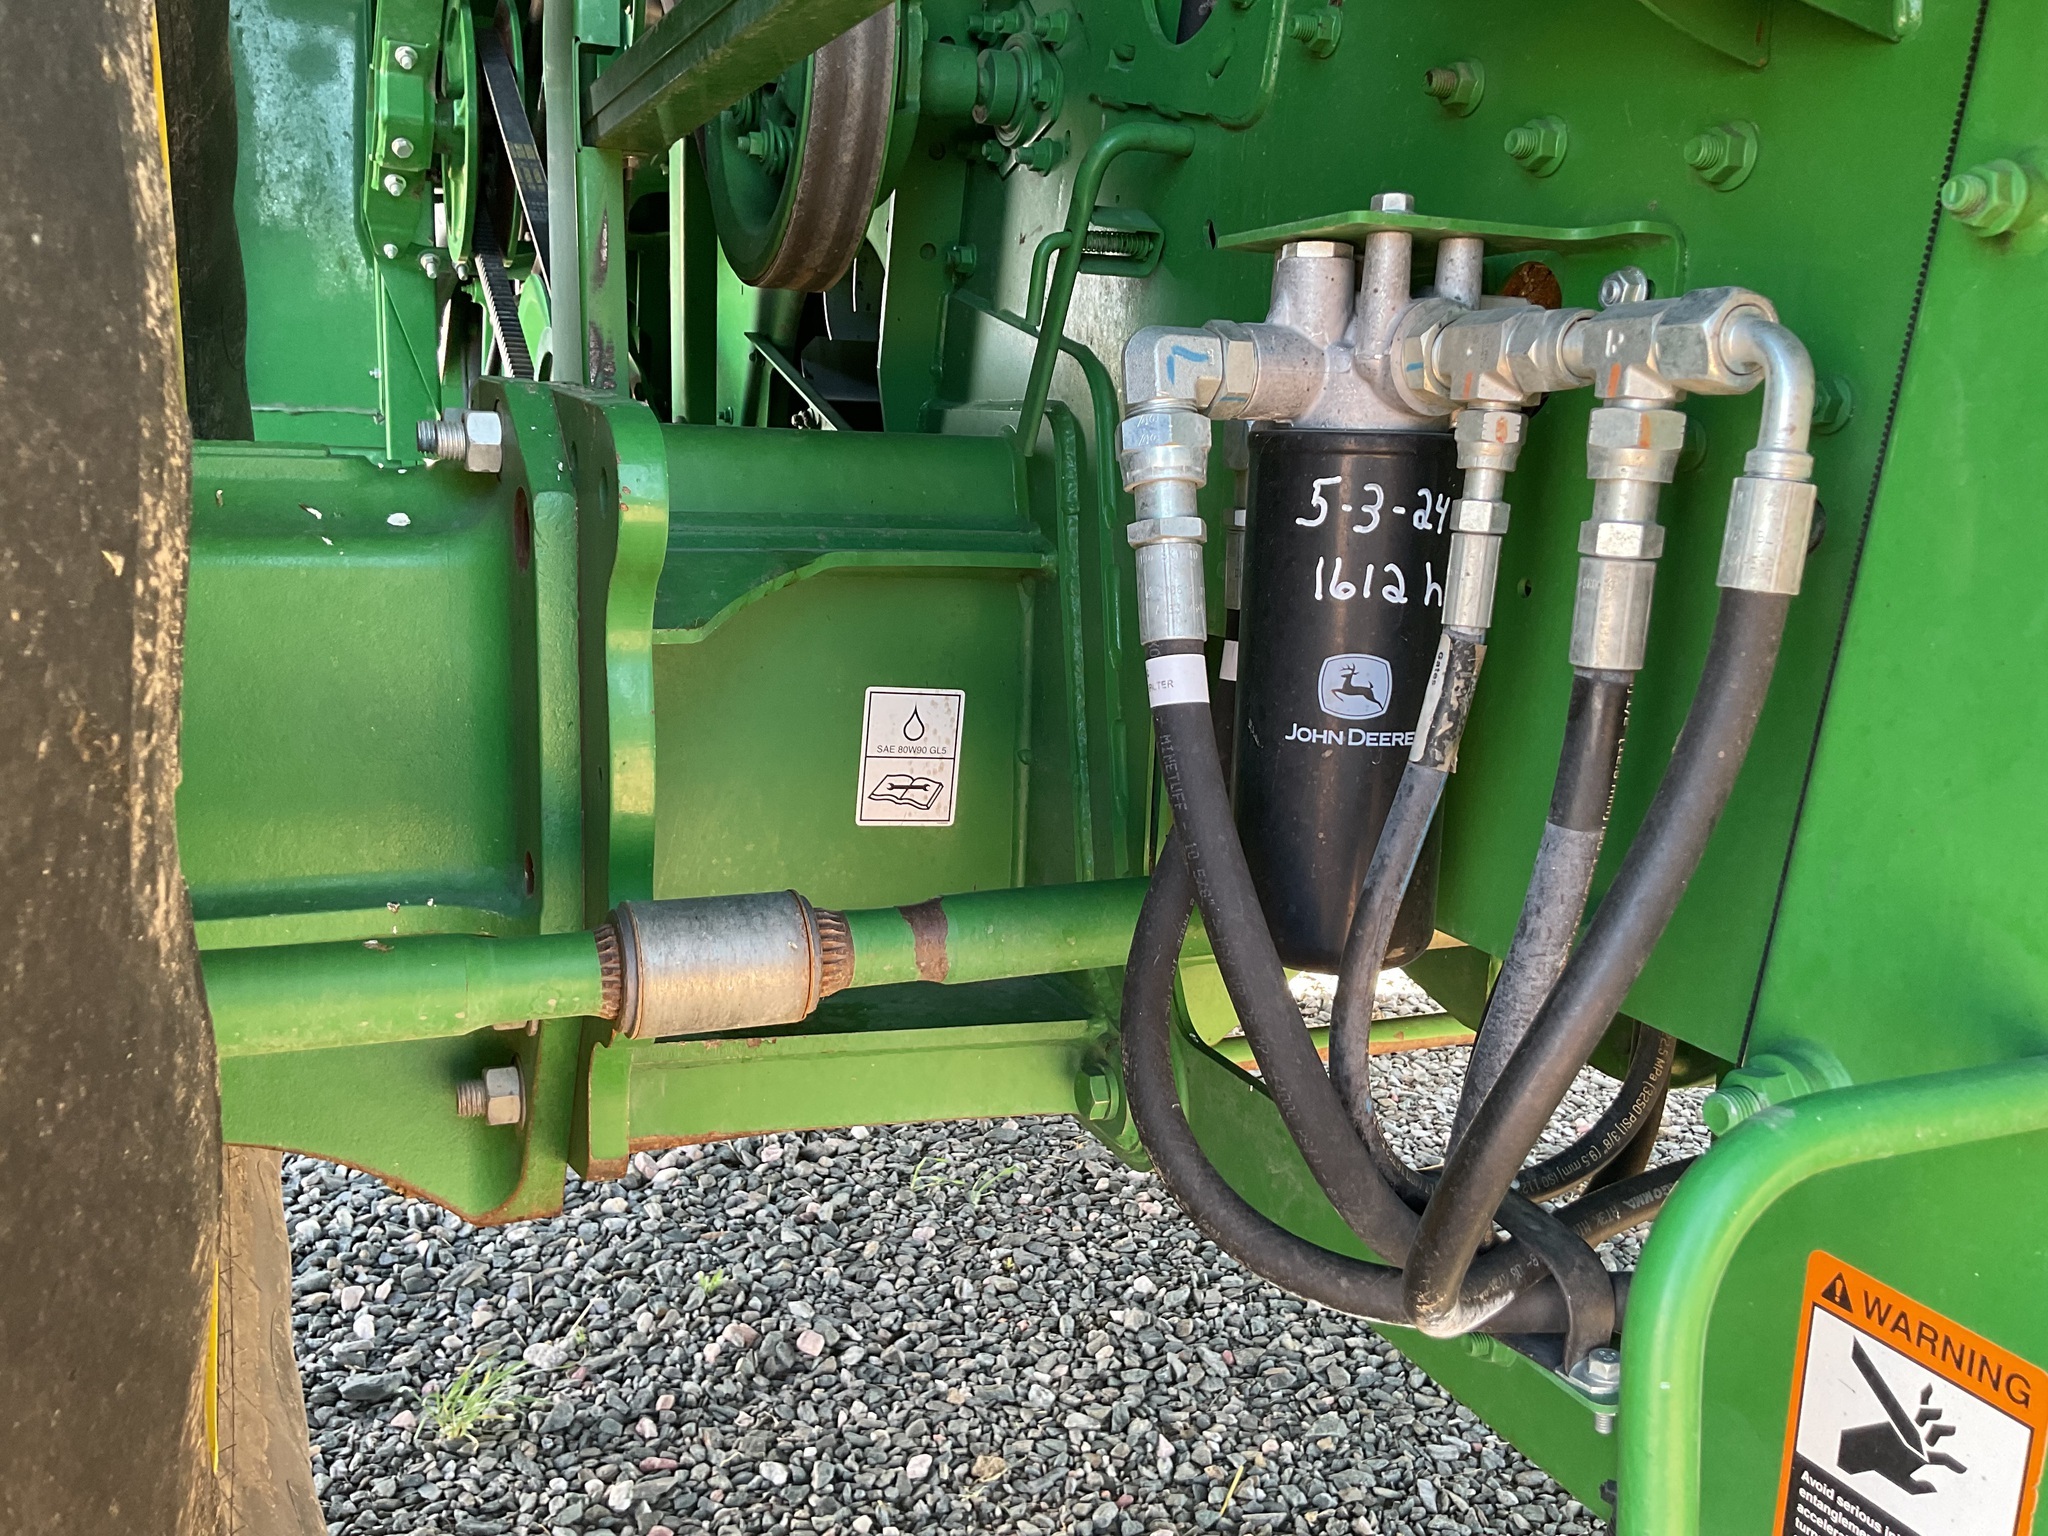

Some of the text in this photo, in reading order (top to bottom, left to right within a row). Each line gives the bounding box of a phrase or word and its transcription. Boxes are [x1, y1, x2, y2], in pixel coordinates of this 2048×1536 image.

[1295, 475, 1450, 534] 5-3-24
[1314, 556, 1409, 604] 1612
[1431, 651, 1444, 686] Gates
[876, 745, 947, 755] SAE 80W90 GL5
[1284, 722, 1416, 747] JOHN DEERE
[1649, 1057, 1666, 1082] MPa
[1621, 1182, 1674, 1210] GOMMA
[1862, 1289, 2033, 1410] WARNING
[1798, 1487, 1871, 1536] entangleme
[1800, 1470, 1836, 1501] Avoid
[1836, 1495, 1883, 1534] serious
